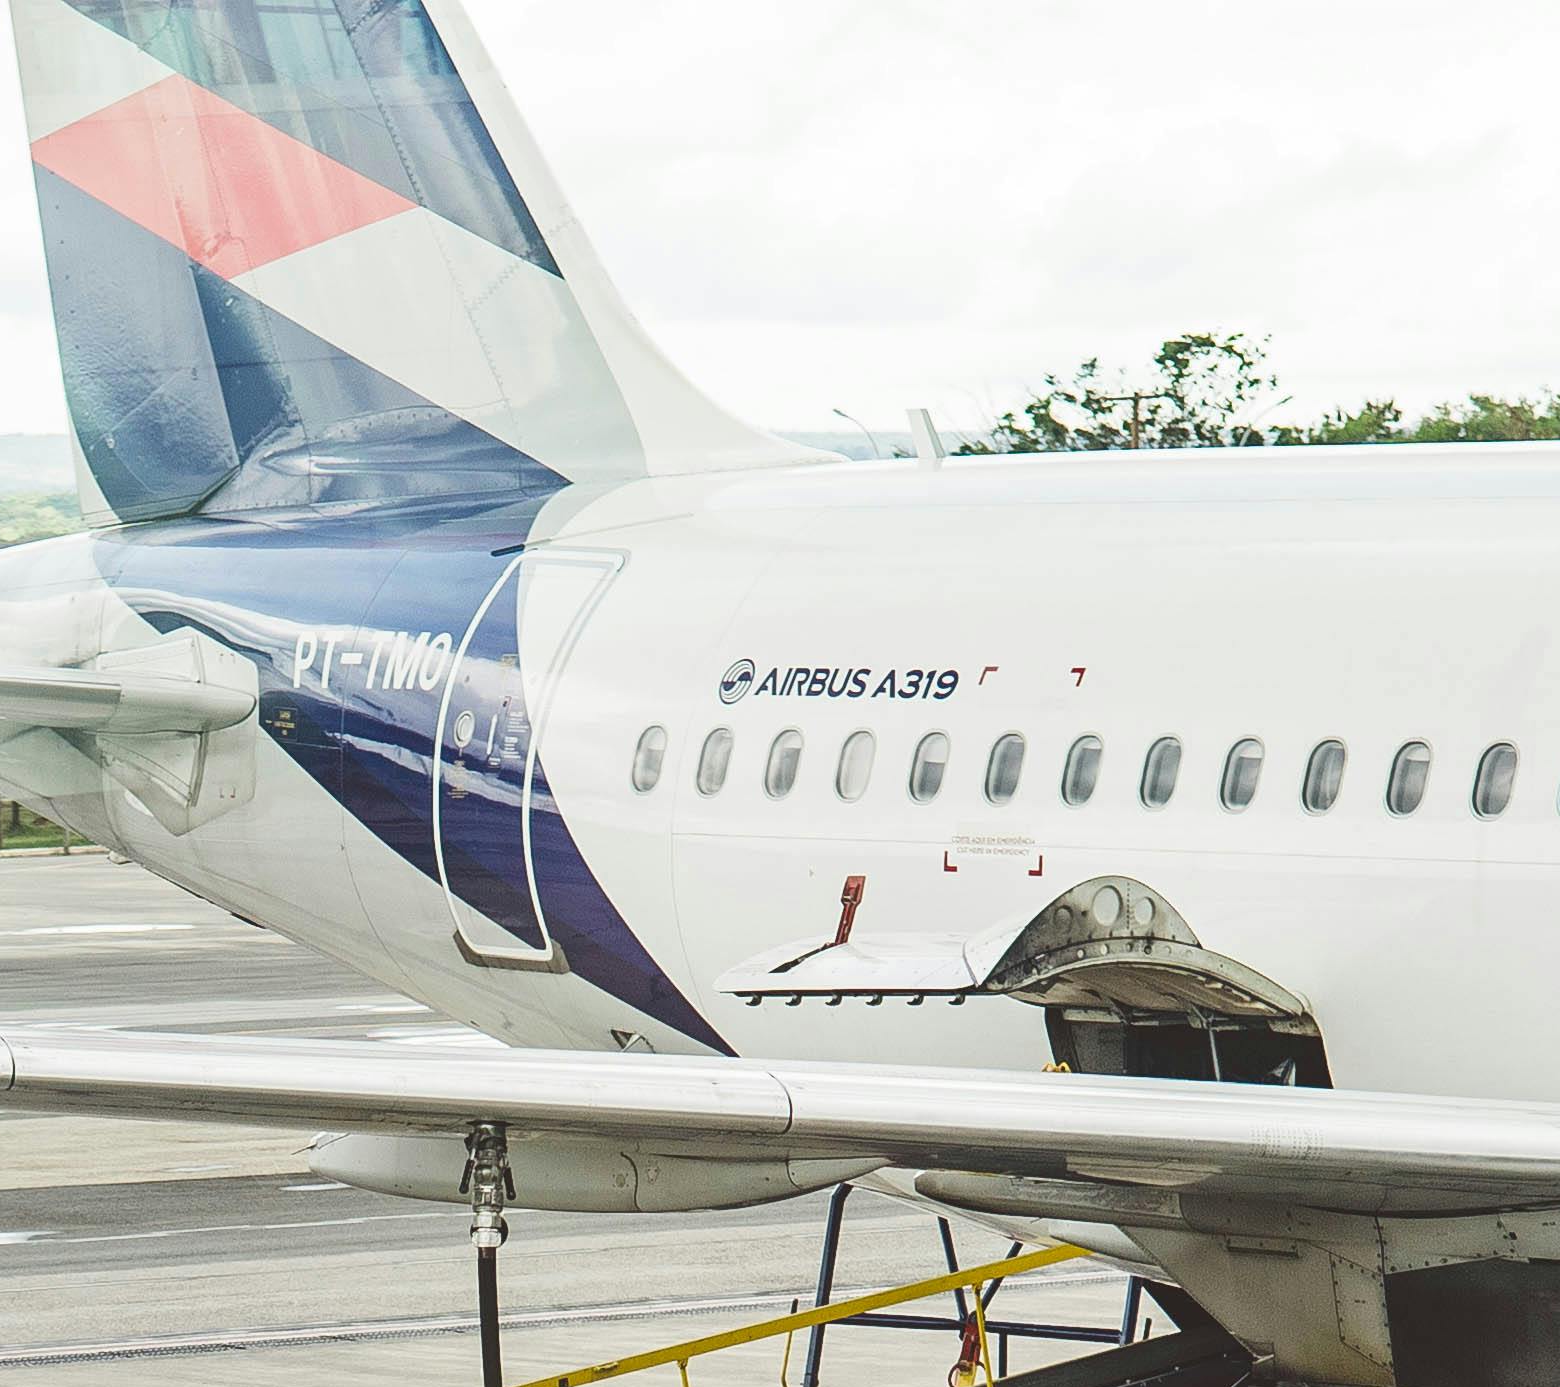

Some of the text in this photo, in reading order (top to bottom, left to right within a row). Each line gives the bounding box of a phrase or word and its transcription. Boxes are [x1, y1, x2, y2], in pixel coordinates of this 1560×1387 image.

[293, 631, 454, 691] PT-TMO
[754, 667, 959, 700] AIRBUS A319
